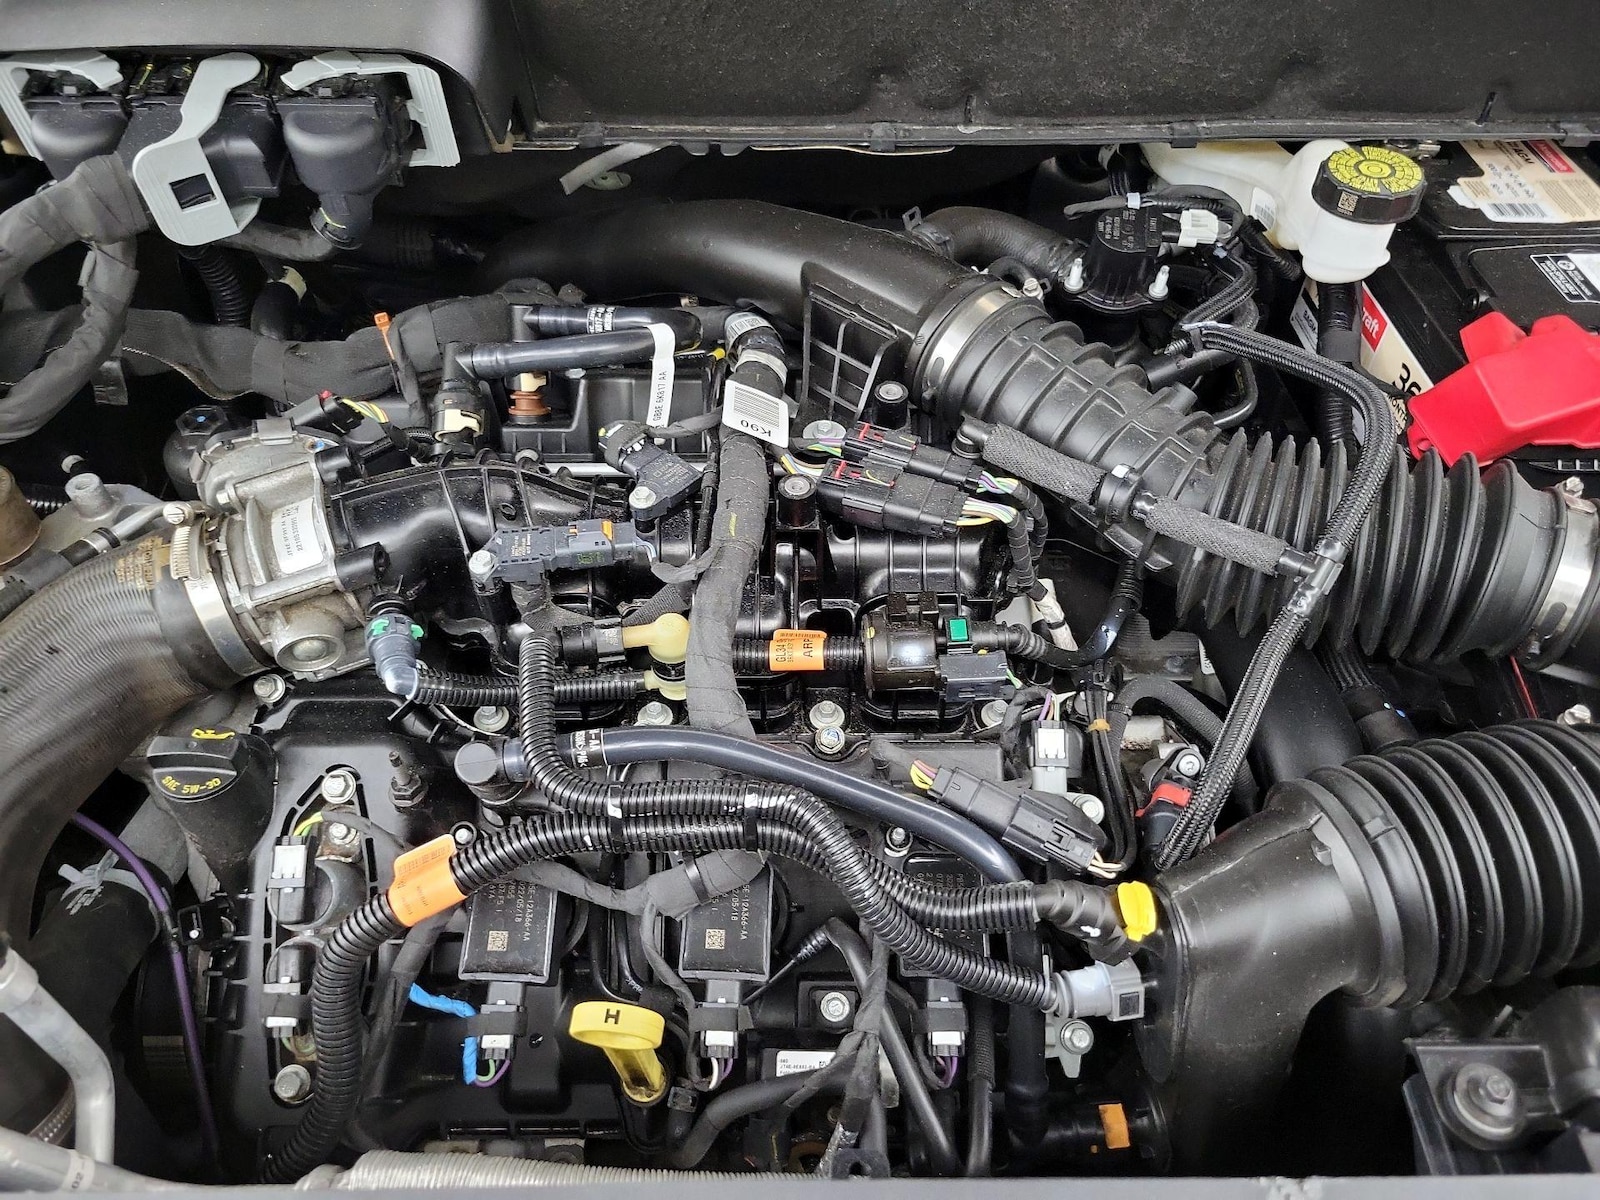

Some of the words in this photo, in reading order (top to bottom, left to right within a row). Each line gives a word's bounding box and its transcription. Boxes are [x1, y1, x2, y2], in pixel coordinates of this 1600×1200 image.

[740, 419, 772, 438] K90
[161, 775, 181, 791] SAE
[181, 777, 222, 794] 5W-30
[603, 1008, 621, 1025] H
